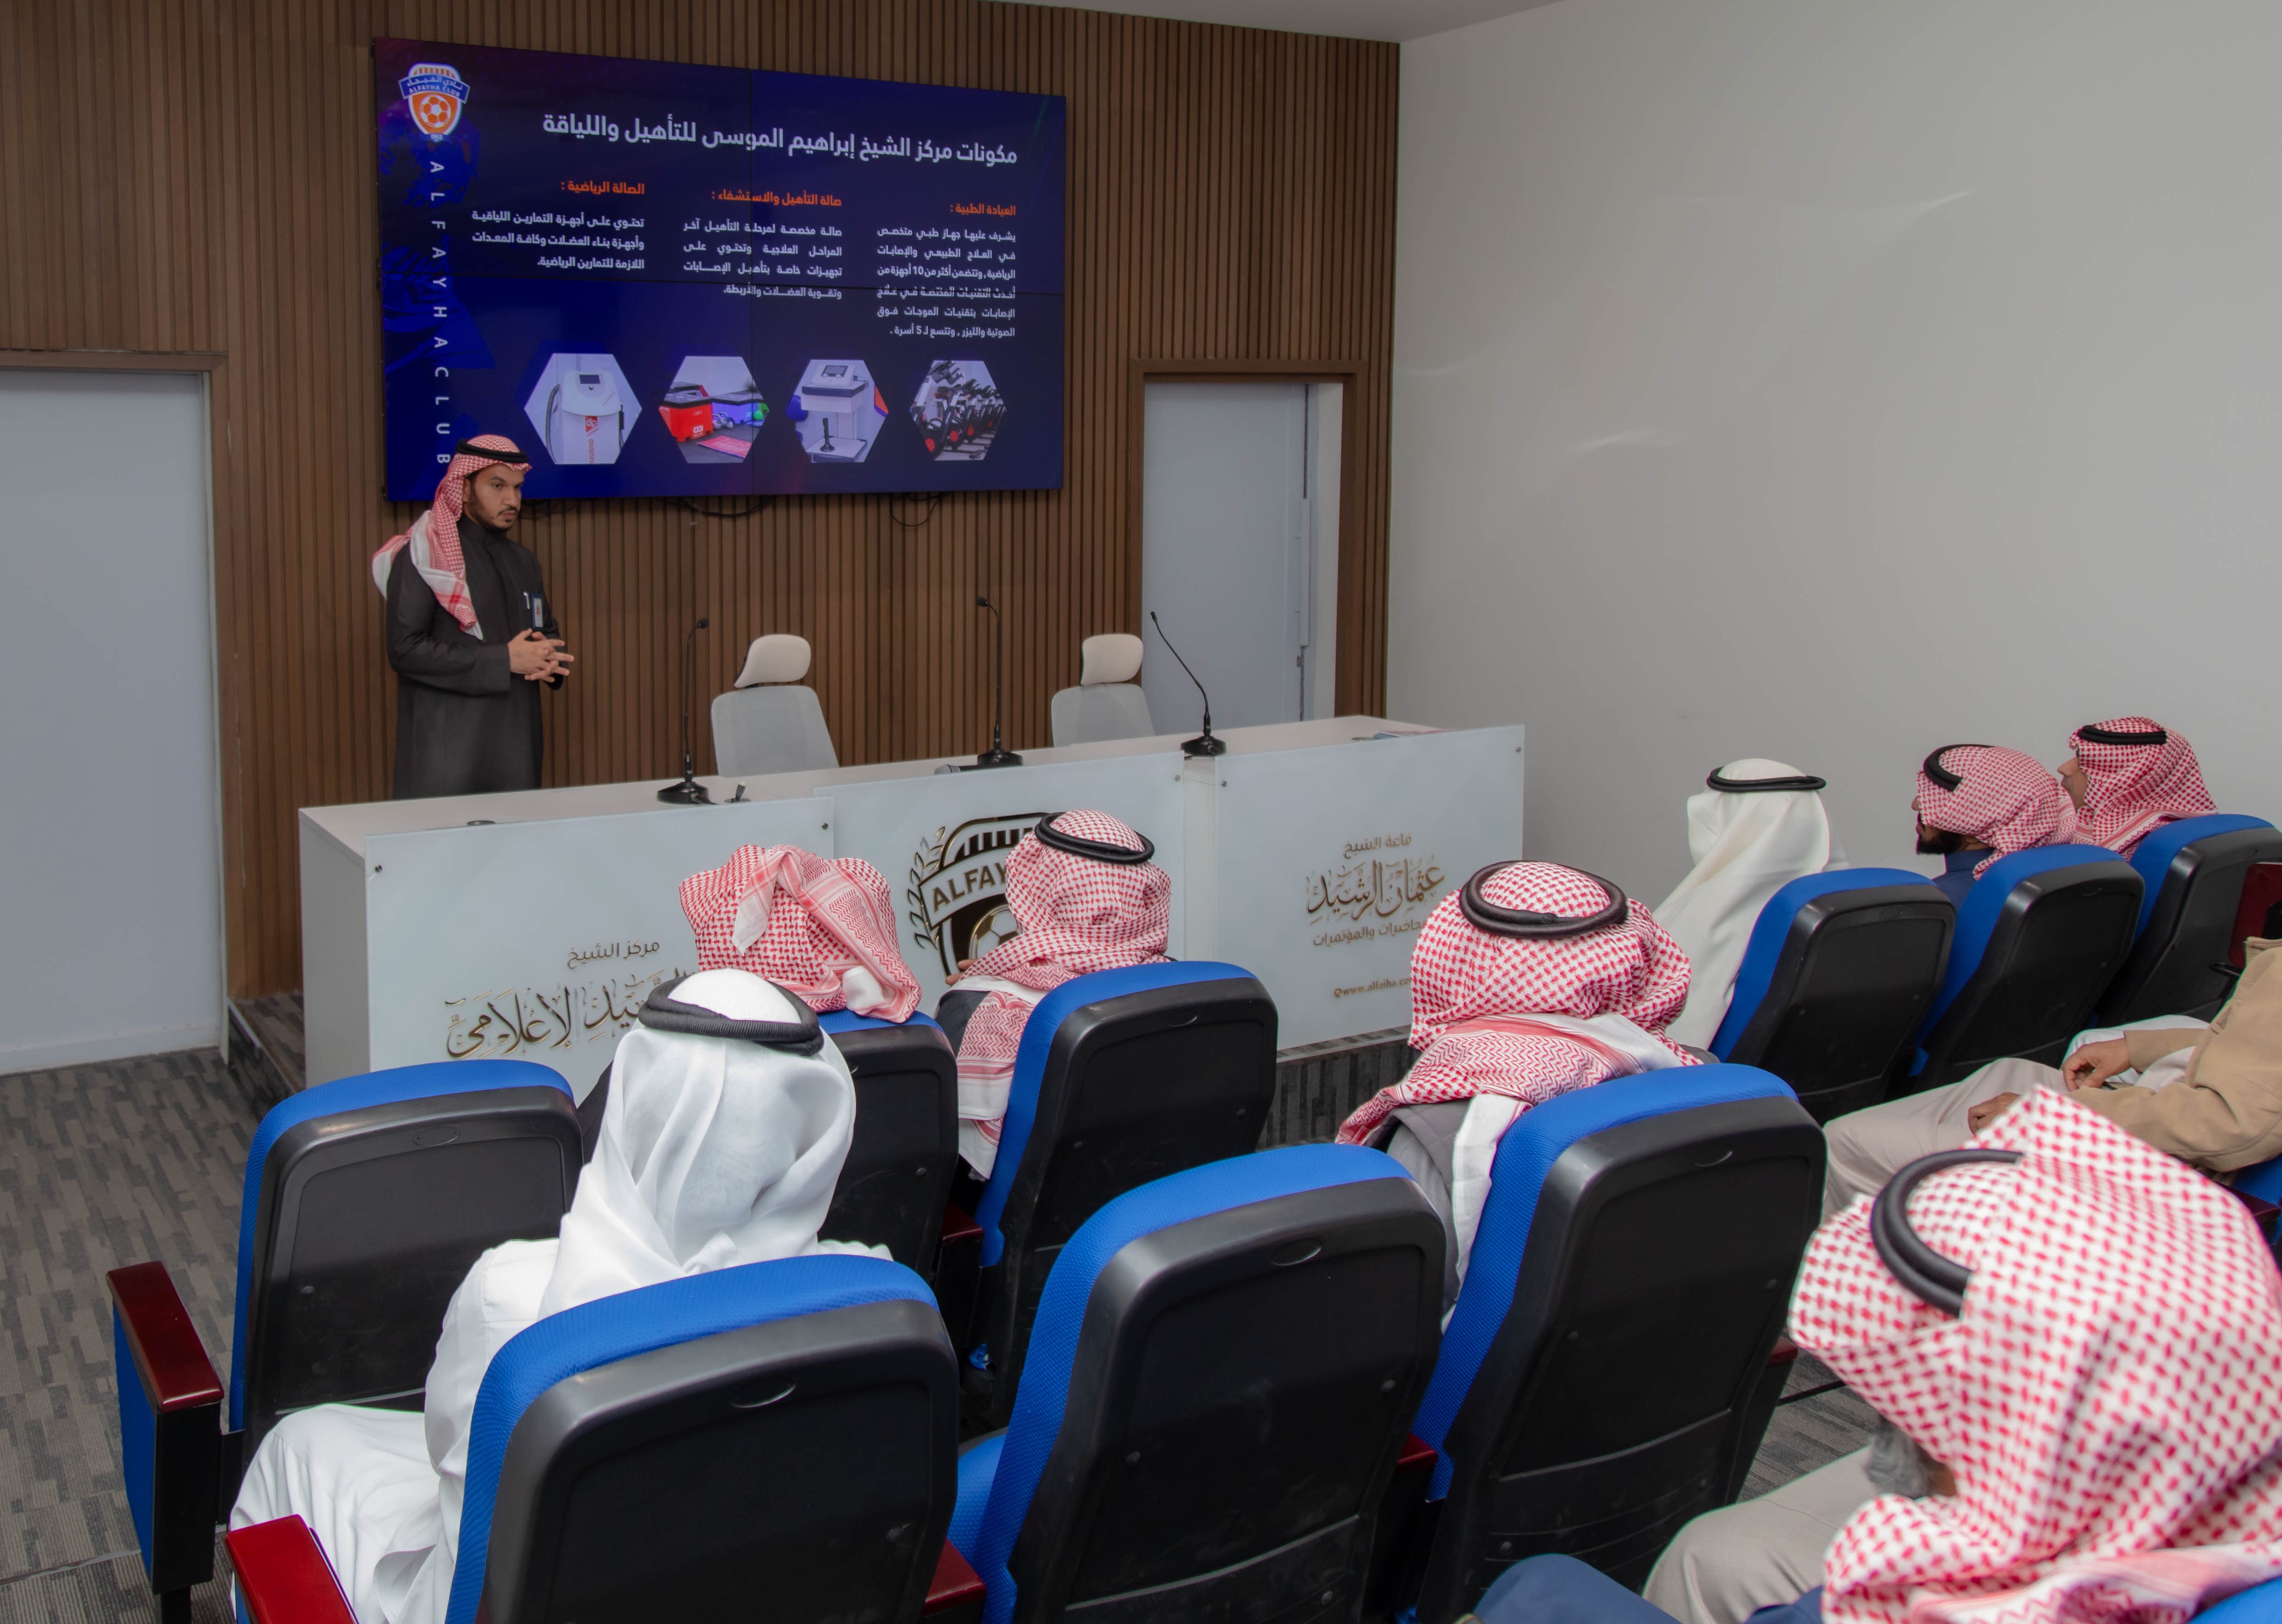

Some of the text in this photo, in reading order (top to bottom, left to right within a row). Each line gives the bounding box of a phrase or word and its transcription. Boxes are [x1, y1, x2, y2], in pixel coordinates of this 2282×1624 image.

[409, 85, 461, 97] ALFAYHA CLUB
[543, 113, 1017, 167] مكونات مركز الشيخ إبراهيم الموسى للتأهيل واللياقة
[567, 180, 610, 195] الرياضية
[612, 182, 645, 194] الصالة
[718, 189, 780, 206] والاستشفاء
[781, 190, 818, 206] التأهيل
[820, 195, 842, 206] صالة
[955, 203, 984, 215] الطبية
[986, 204, 1016, 217] العيادة
[472, 210, 645, 231] تحتوي على أجهزة التمارين اللياقية
[683, 218, 842, 236] صالة مخصصة لمرحلة التأهيل آخر
[472, 231, 644, 251] وأجهزة بناء العضلات وكافة المعدات
[877, 227, 1016, 242] يشرف عليها جهاز طبي متخصص
[683, 241, 842, 258] المراحل العلاجية وتحتوي على
[877, 245, 1016, 263] في العلاج الطبيعي والإصابات
[577, 257, 614, 269] للتمارين
[615, 259, 645, 271] اللازمة
[683, 260, 843, 279] تجهيزات خاصة بتأهيل الإصابات
[877, 266, 890, 276] من
[891, 263, 911, 278] أجهزة
[913, 266, 924, 275] 10
[924, 269, 937, 278] من
[937, 264, 951, 278] أكثر
[763, 286, 806, 296] العضلات
[807, 289, 842, 300] وتقوية
[877, 306, 1015, 320] الإصابات بتقنيات الموجات فوق
[894, 322, 914, 335] أسرة
[916, 325, 922, 335] 5
[930, 327, 955, 339] وتتسع
[961, 327, 985, 338] والليزر
[987, 327, 1015, 339] الصوتية
[1343, 835, 1382, 859] الشيخ
[1314, 927, 1375, 947] والمؤتمرات
[566, 938, 660, 970] مركز الشيخ
